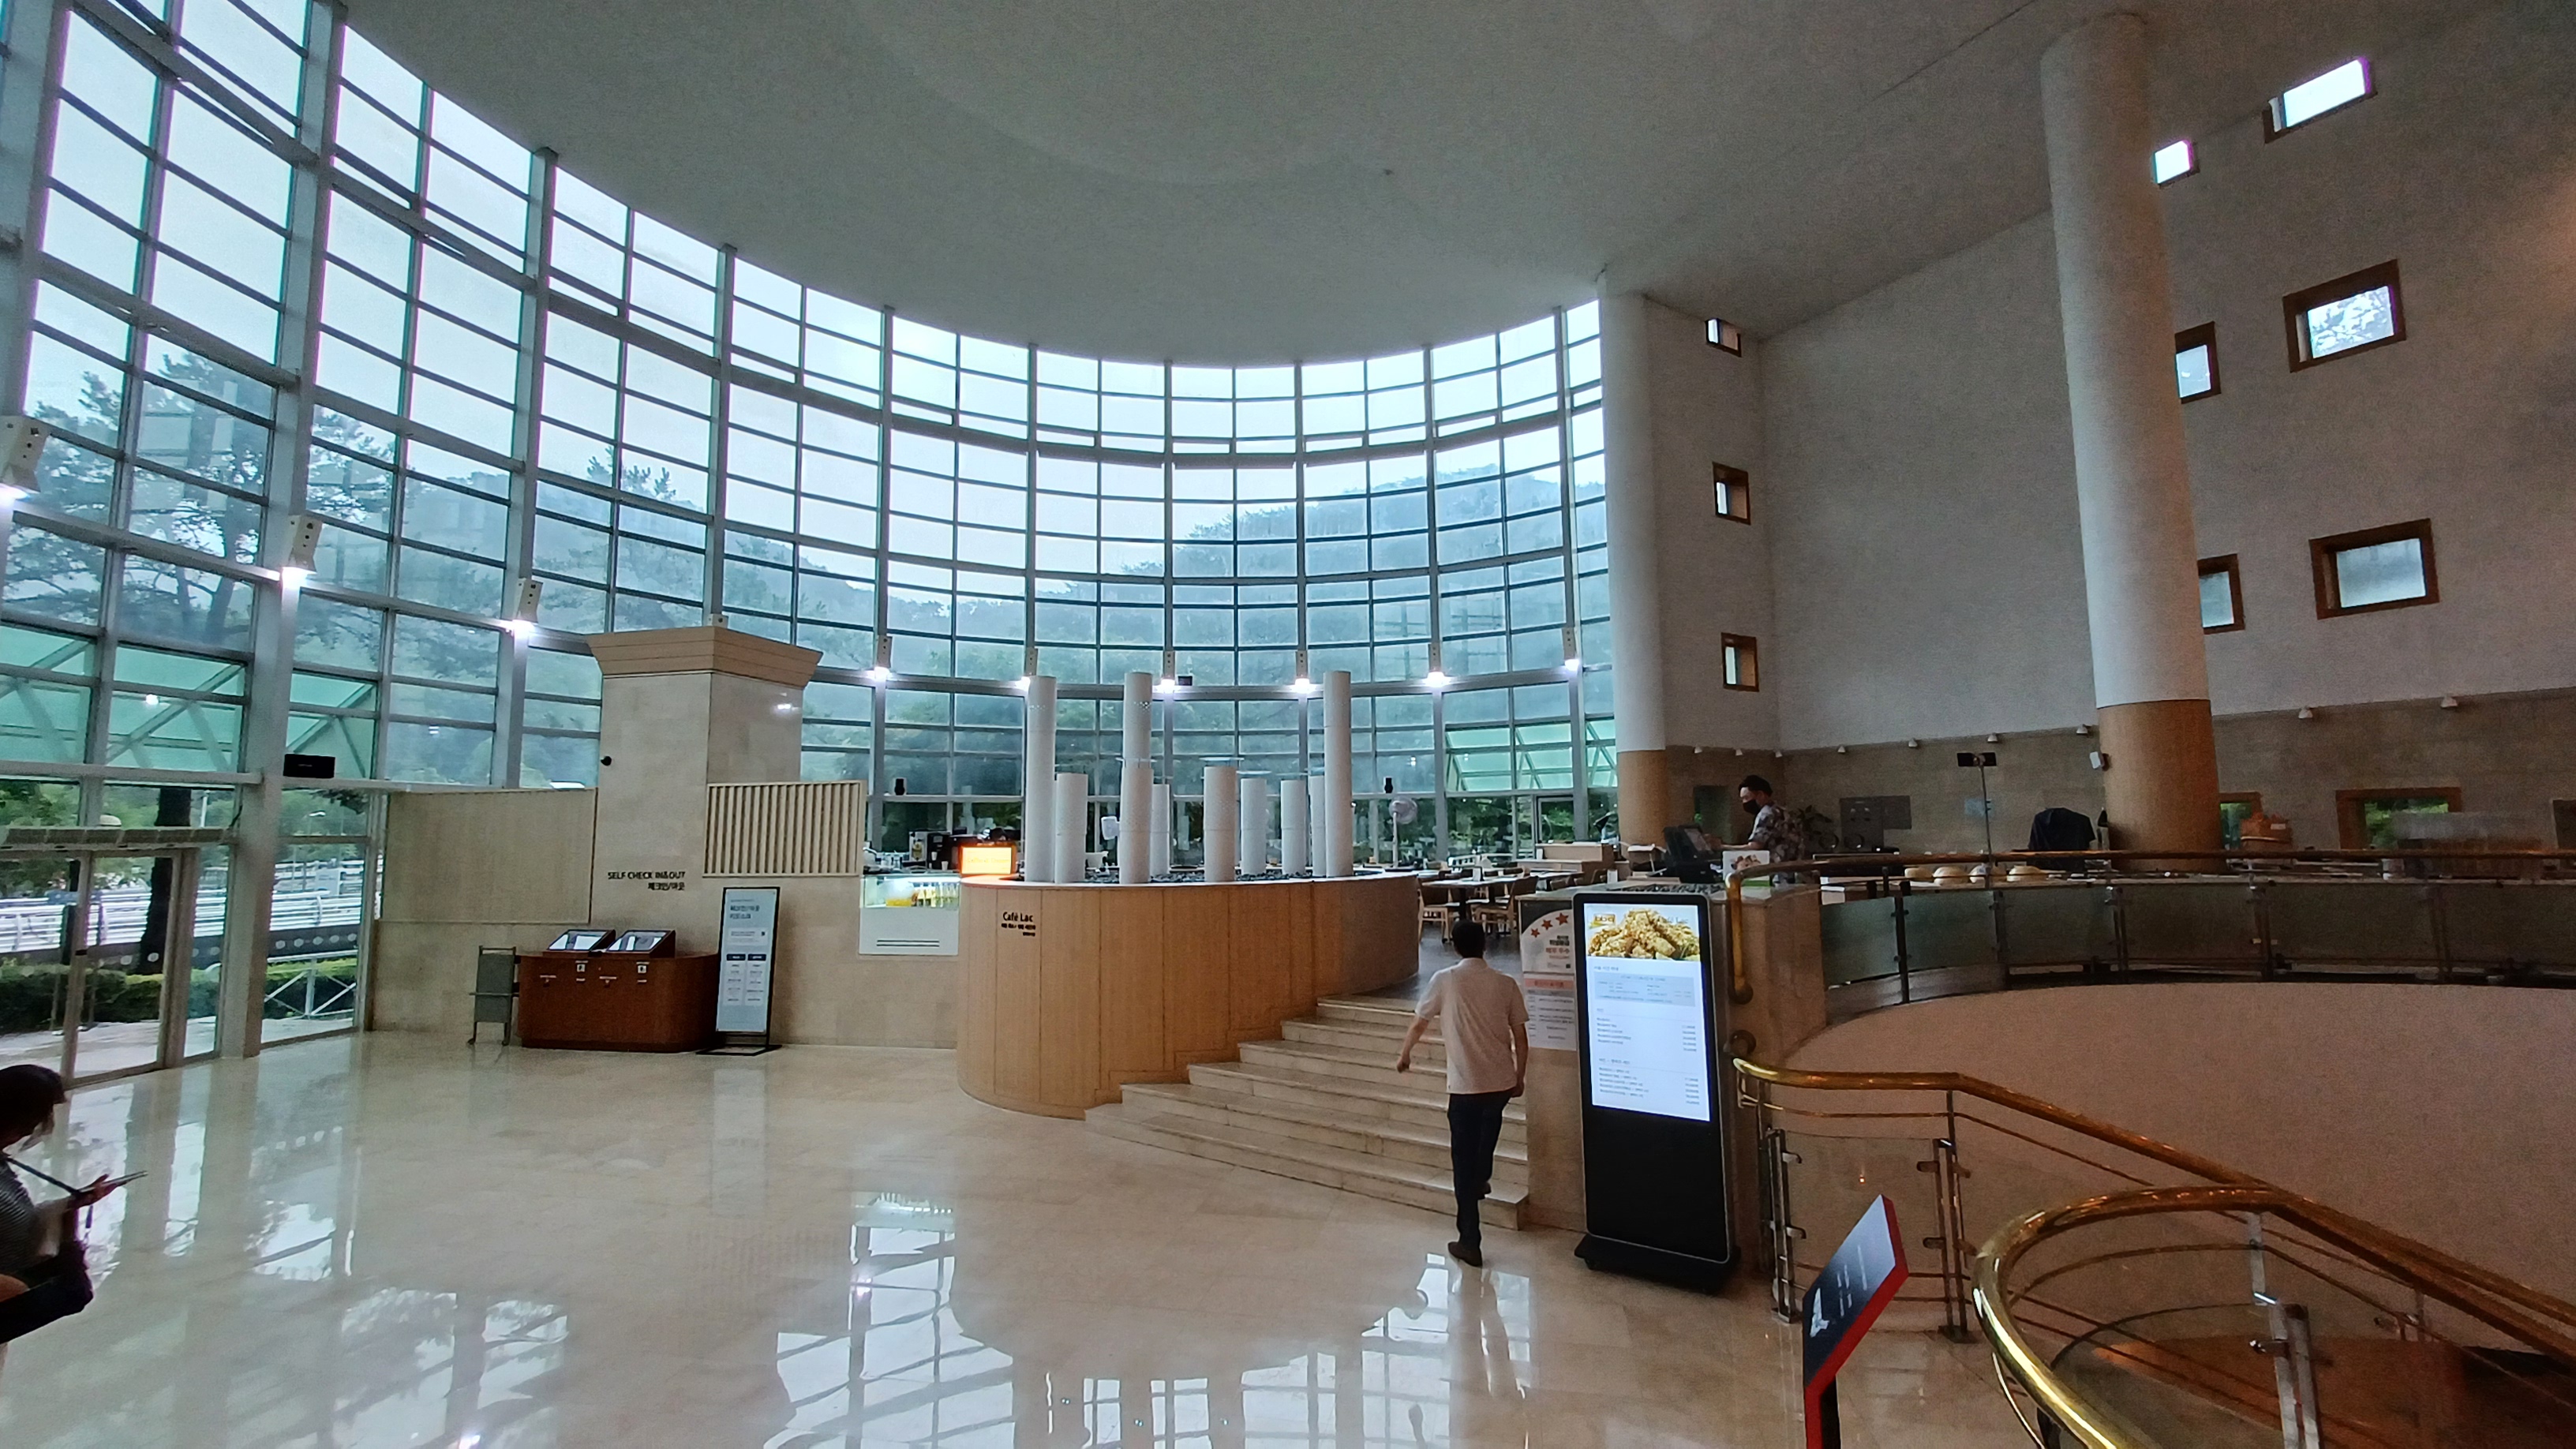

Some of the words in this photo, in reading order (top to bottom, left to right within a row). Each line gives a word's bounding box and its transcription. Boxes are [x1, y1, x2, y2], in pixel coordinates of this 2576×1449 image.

[608, 871, 626, 880] SELF
[627, 871, 653, 880] CHECK
[1020, 912, 1033, 923] Lac
